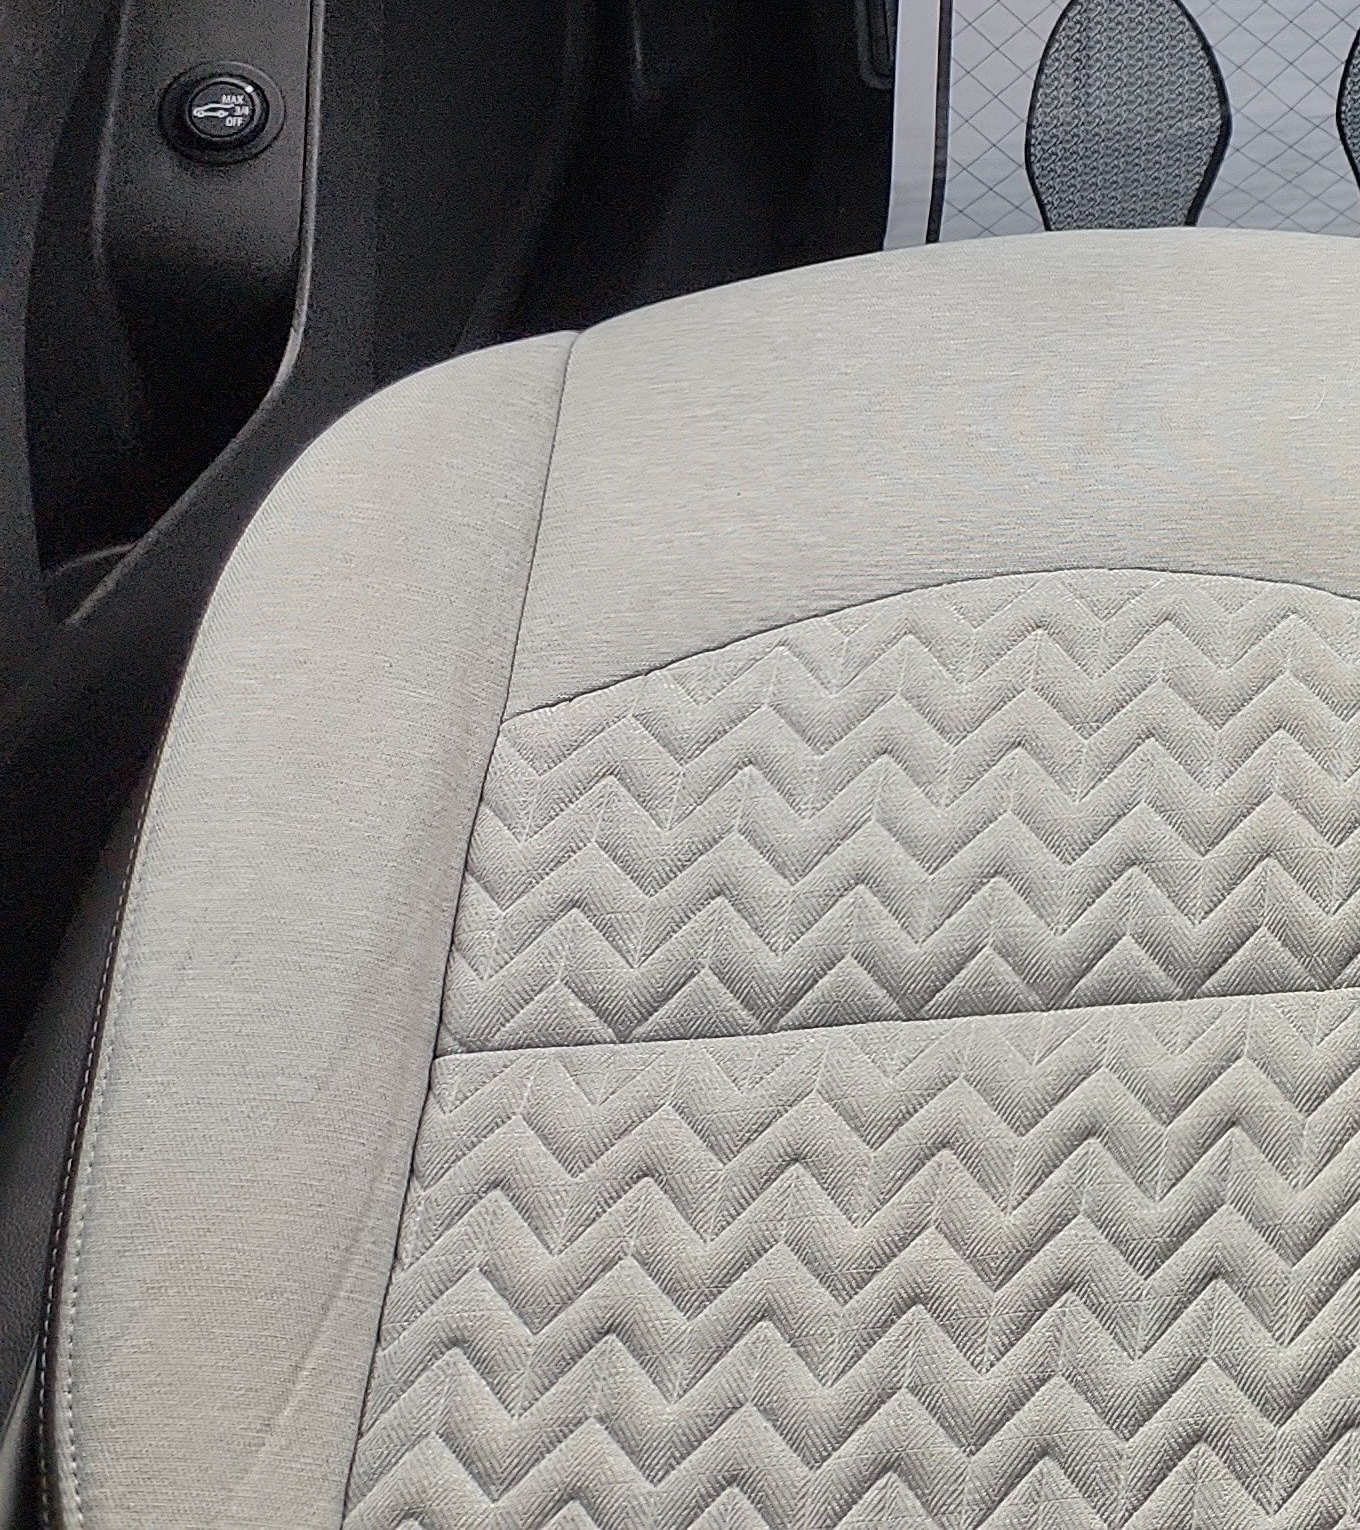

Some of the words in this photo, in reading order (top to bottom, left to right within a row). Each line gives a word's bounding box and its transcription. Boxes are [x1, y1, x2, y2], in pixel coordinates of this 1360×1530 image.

[222, 95, 244, 104] MAX
[235, 106, 249, 115] 3/4
[226, 117, 243, 126] OFF
